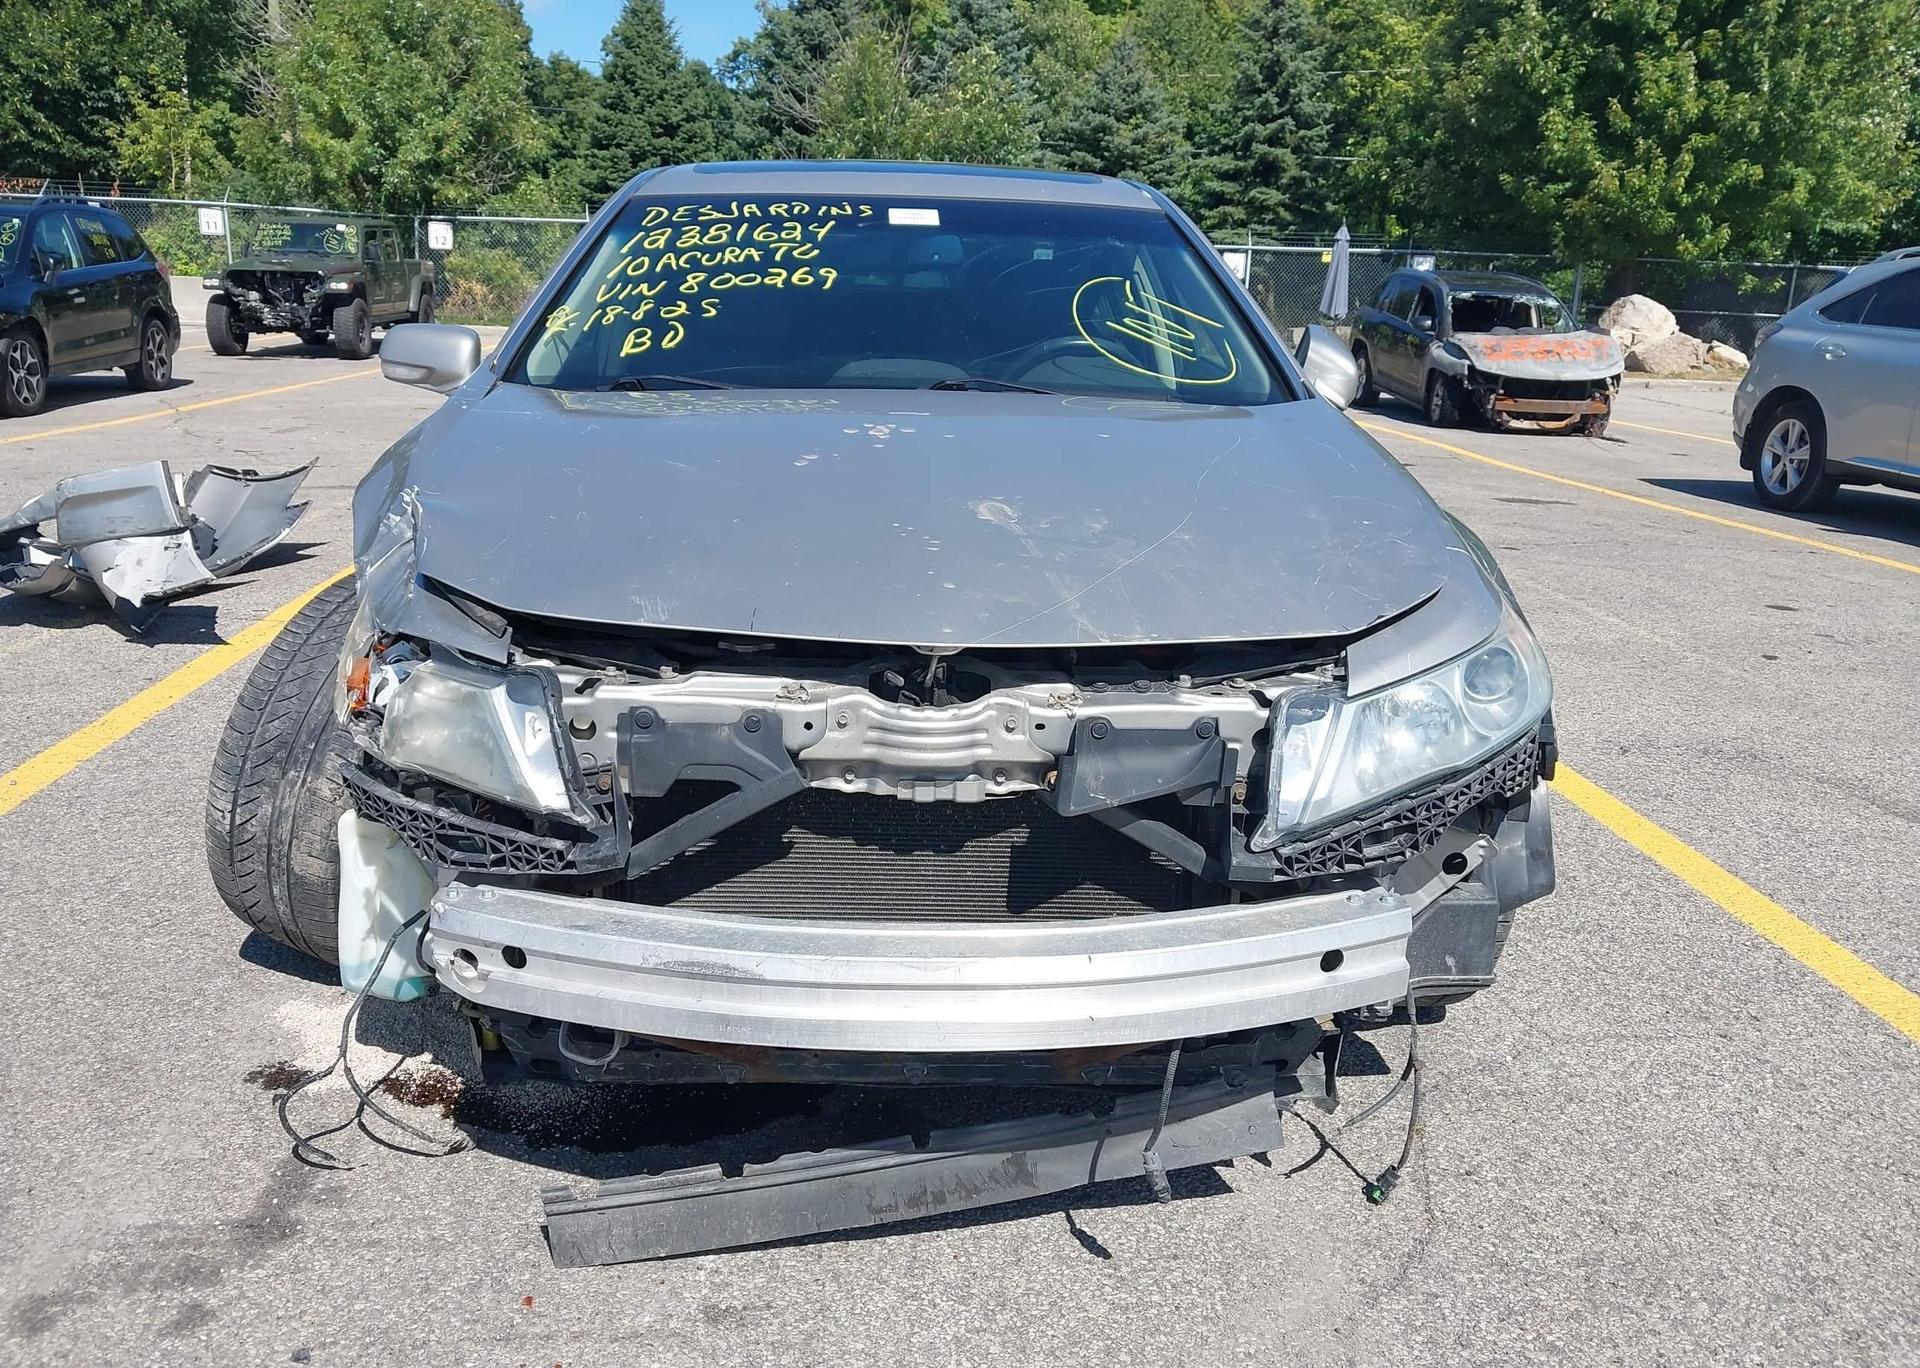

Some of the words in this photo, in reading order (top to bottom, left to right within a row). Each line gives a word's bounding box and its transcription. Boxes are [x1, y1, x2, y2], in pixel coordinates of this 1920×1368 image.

[205, 221, 217, 231] 11
[641, 201, 873, 226] DESJARDINS
[434, 235, 448, 245] 12
[655, 246, 764, 272] ACURA
[596, 280, 667, 303] VIN
[679, 266, 838, 293] 800269
